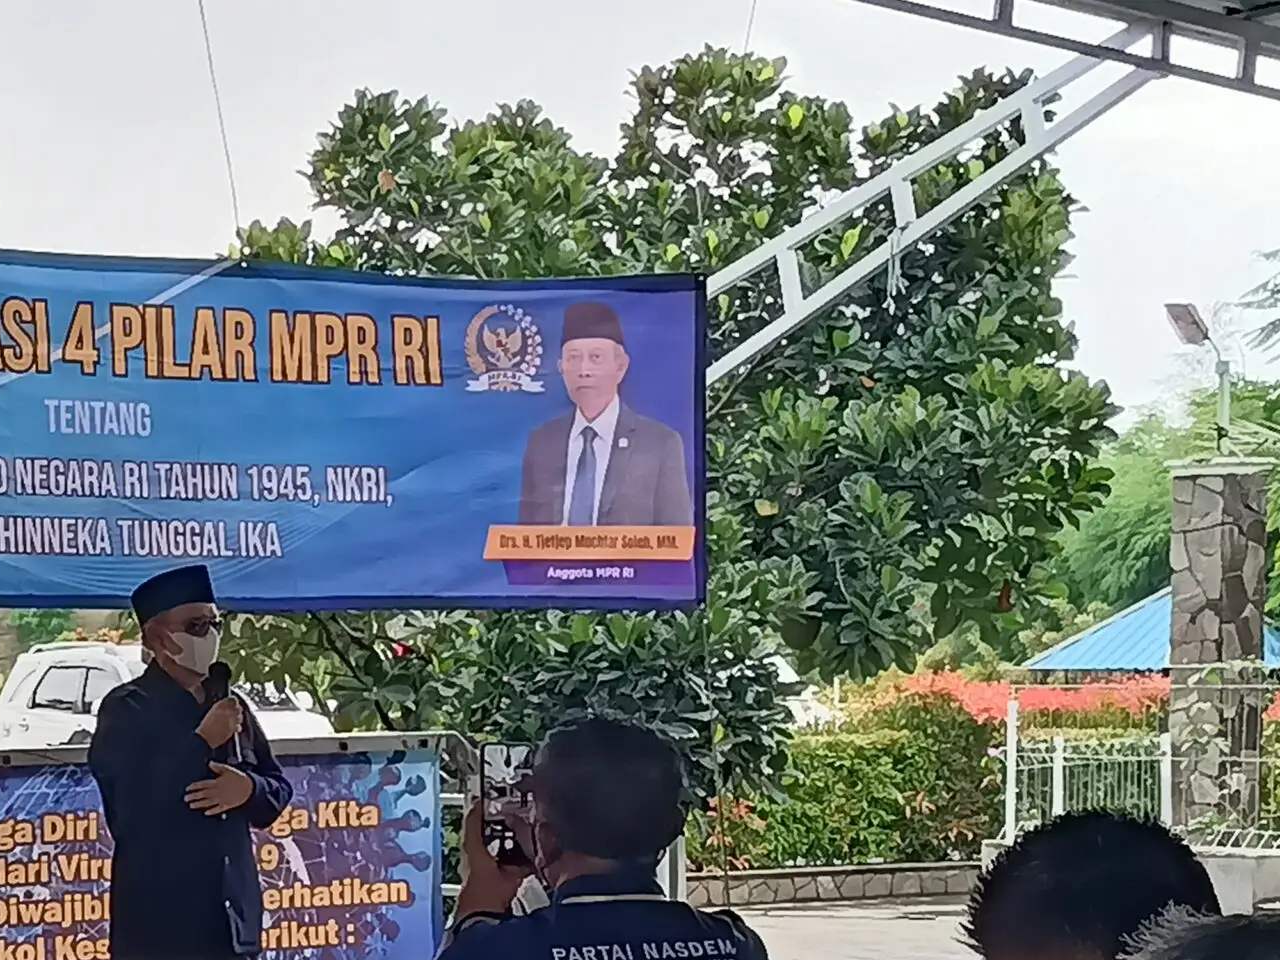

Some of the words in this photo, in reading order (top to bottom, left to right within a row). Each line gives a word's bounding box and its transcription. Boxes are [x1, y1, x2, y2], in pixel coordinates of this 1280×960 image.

[61, 300, 99, 375] 4
[109, 303, 258, 382] PILAR
[269, 309, 382, 385] MPR
[391, 314, 444, 387] RI
[44, 399, 151, 437] TENTANG
[14, 457, 119, 499] NEGARA
[122, 461, 148, 499] RI
[154, 462, 240, 501] TAHUN
[247, 465, 320, 507] 1945,
[325, 465, 393, 507] NKRI,
[117, 519, 234, 557] TUNGGAL
[238, 520, 283, 557] IKA
[547, 567, 594, 580] Anggota
[596, 568, 621, 579] MPR
[42, 812, 99, 843] Diri
[318, 801, 380, 828] Kita
[262, 878, 409, 910] erhatikan
[642, 938, 737, 960] NASDEM
